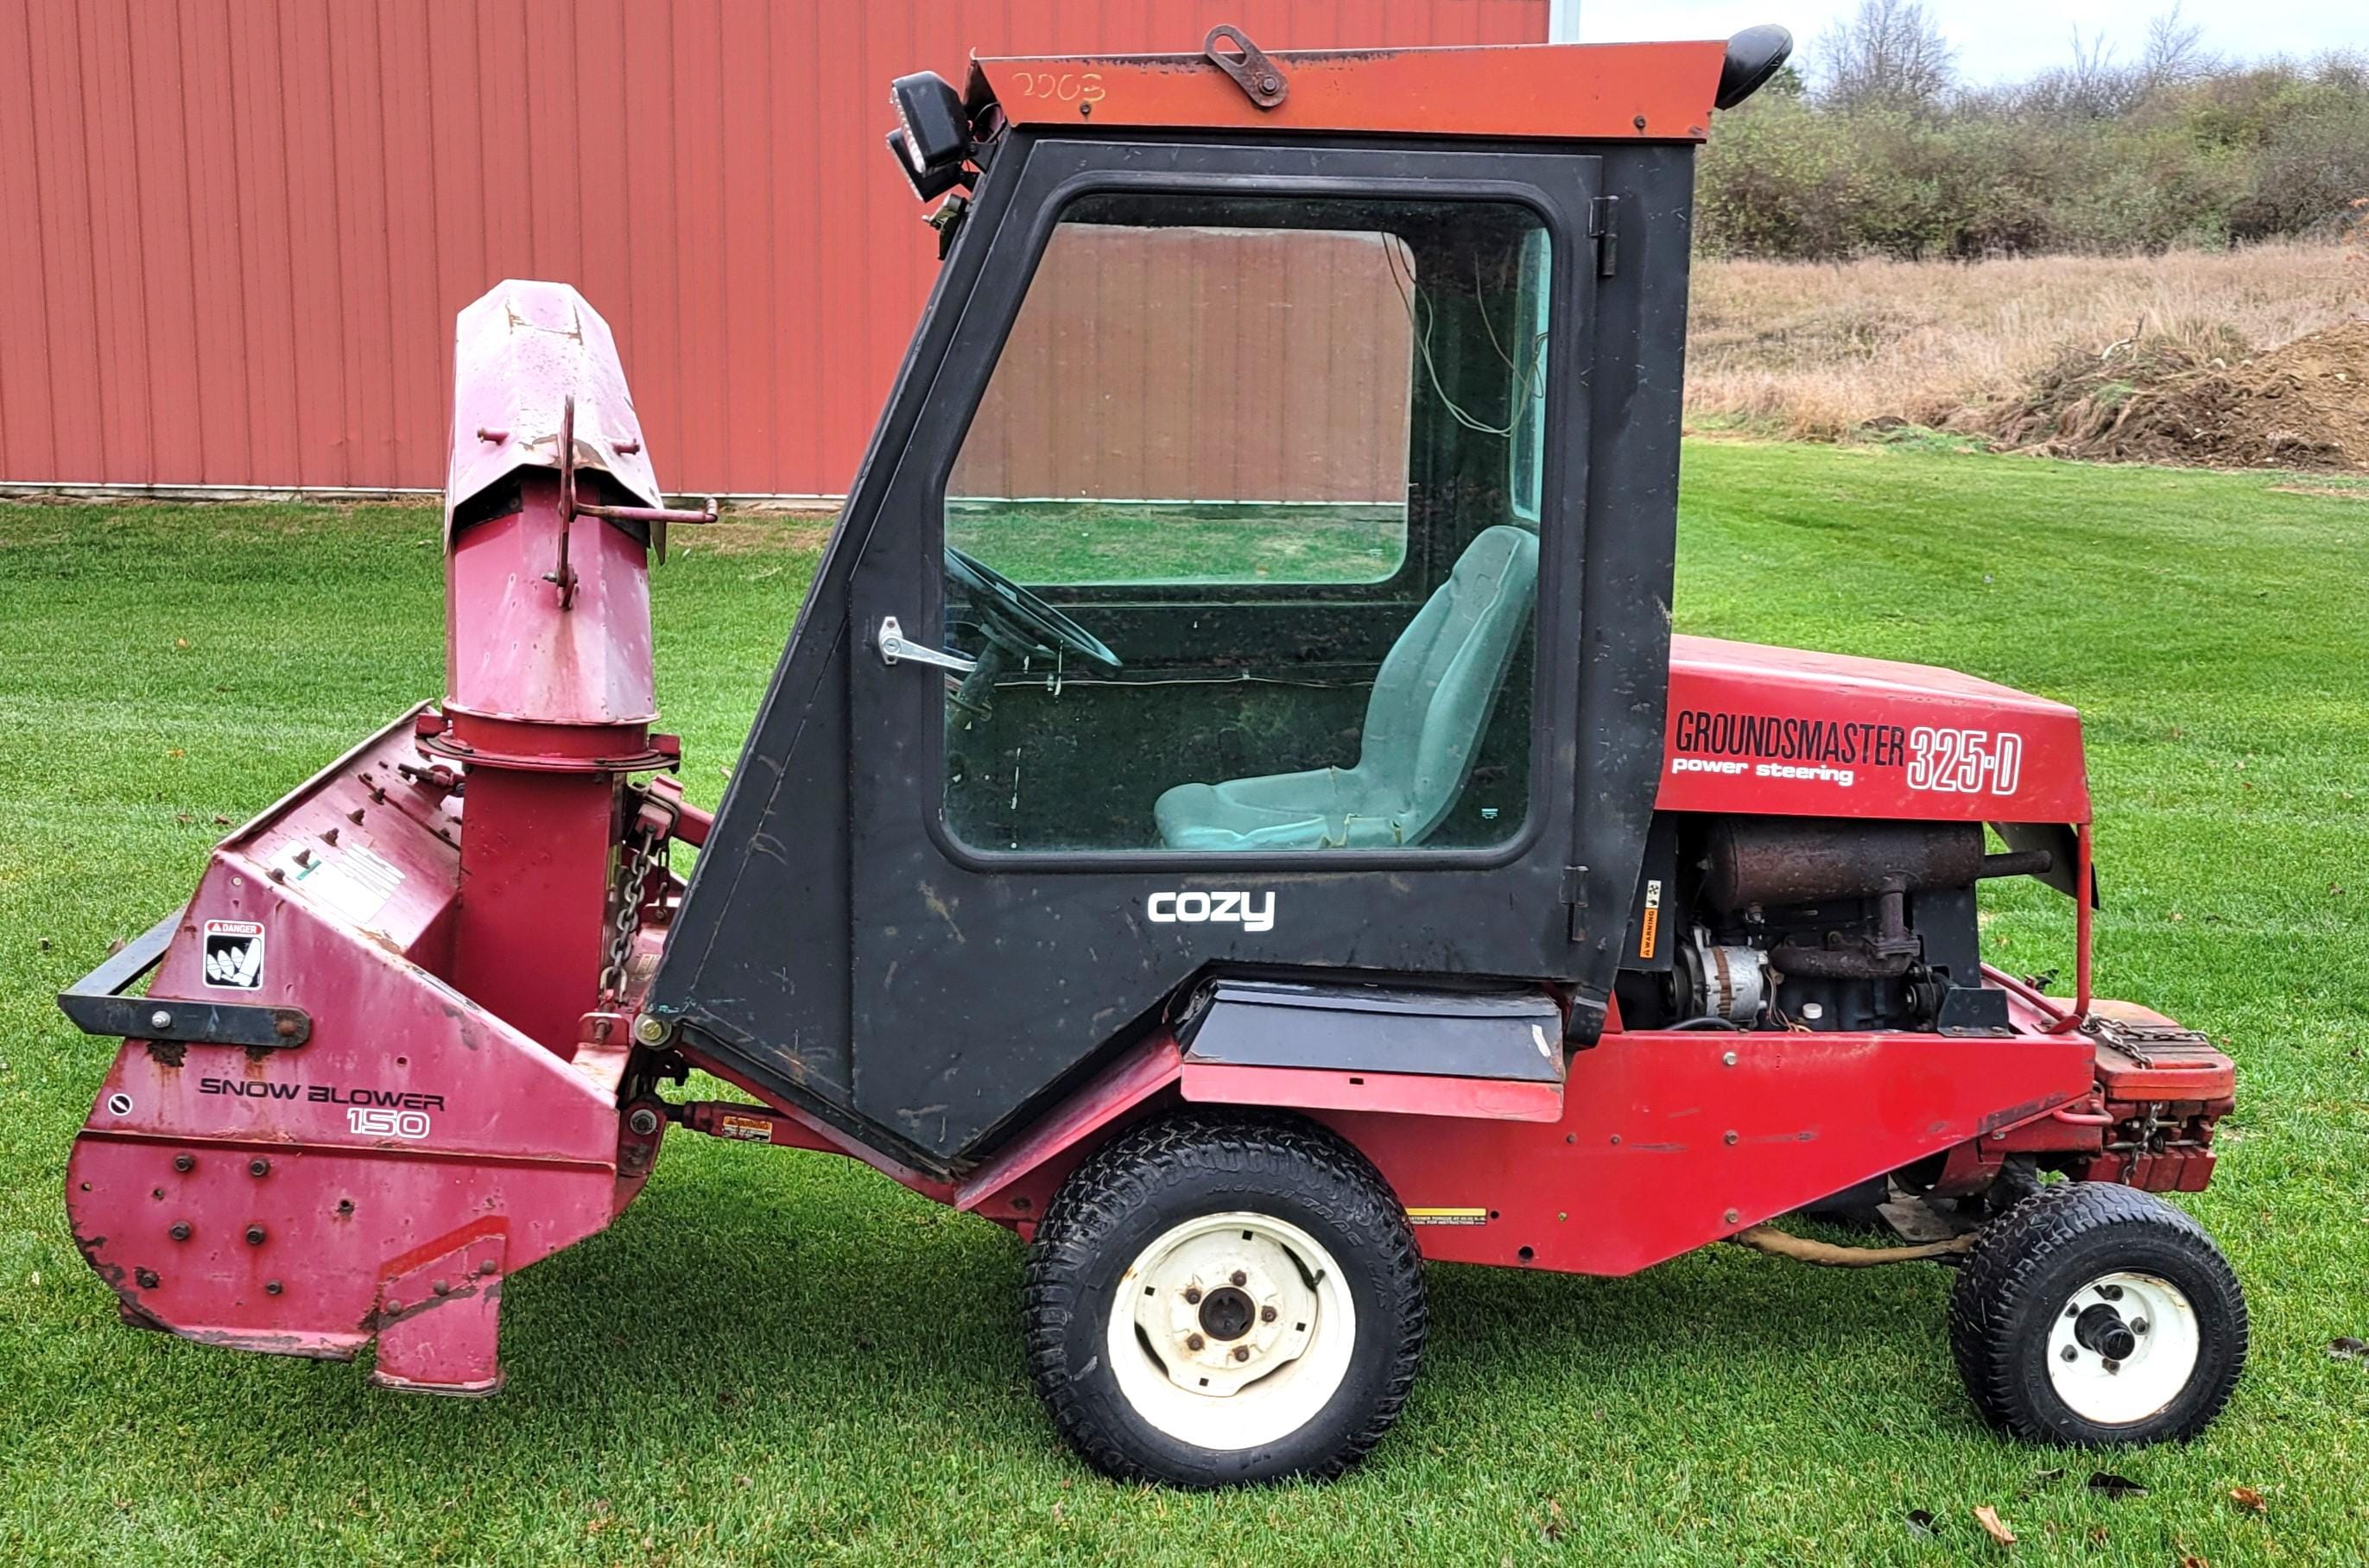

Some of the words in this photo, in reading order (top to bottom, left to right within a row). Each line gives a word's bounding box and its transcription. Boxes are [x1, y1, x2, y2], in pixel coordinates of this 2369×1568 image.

[1675, 710, 1905, 767] GROUNDSMASTER
[1907, 726, 2023, 795] 325-D
[1672, 756, 1749, 775] power
[1755, 762, 1855, 787] steering
[222, 923, 257, 934] DANGER
[1644, 910, 1655, 949] WARNING
[200, 1078, 301, 1100] SNOW
[307, 1085, 445, 1111] BLOWER
[347, 1107, 430, 1139] 150
[1302, 1196, 1365, 1247] TRAC
